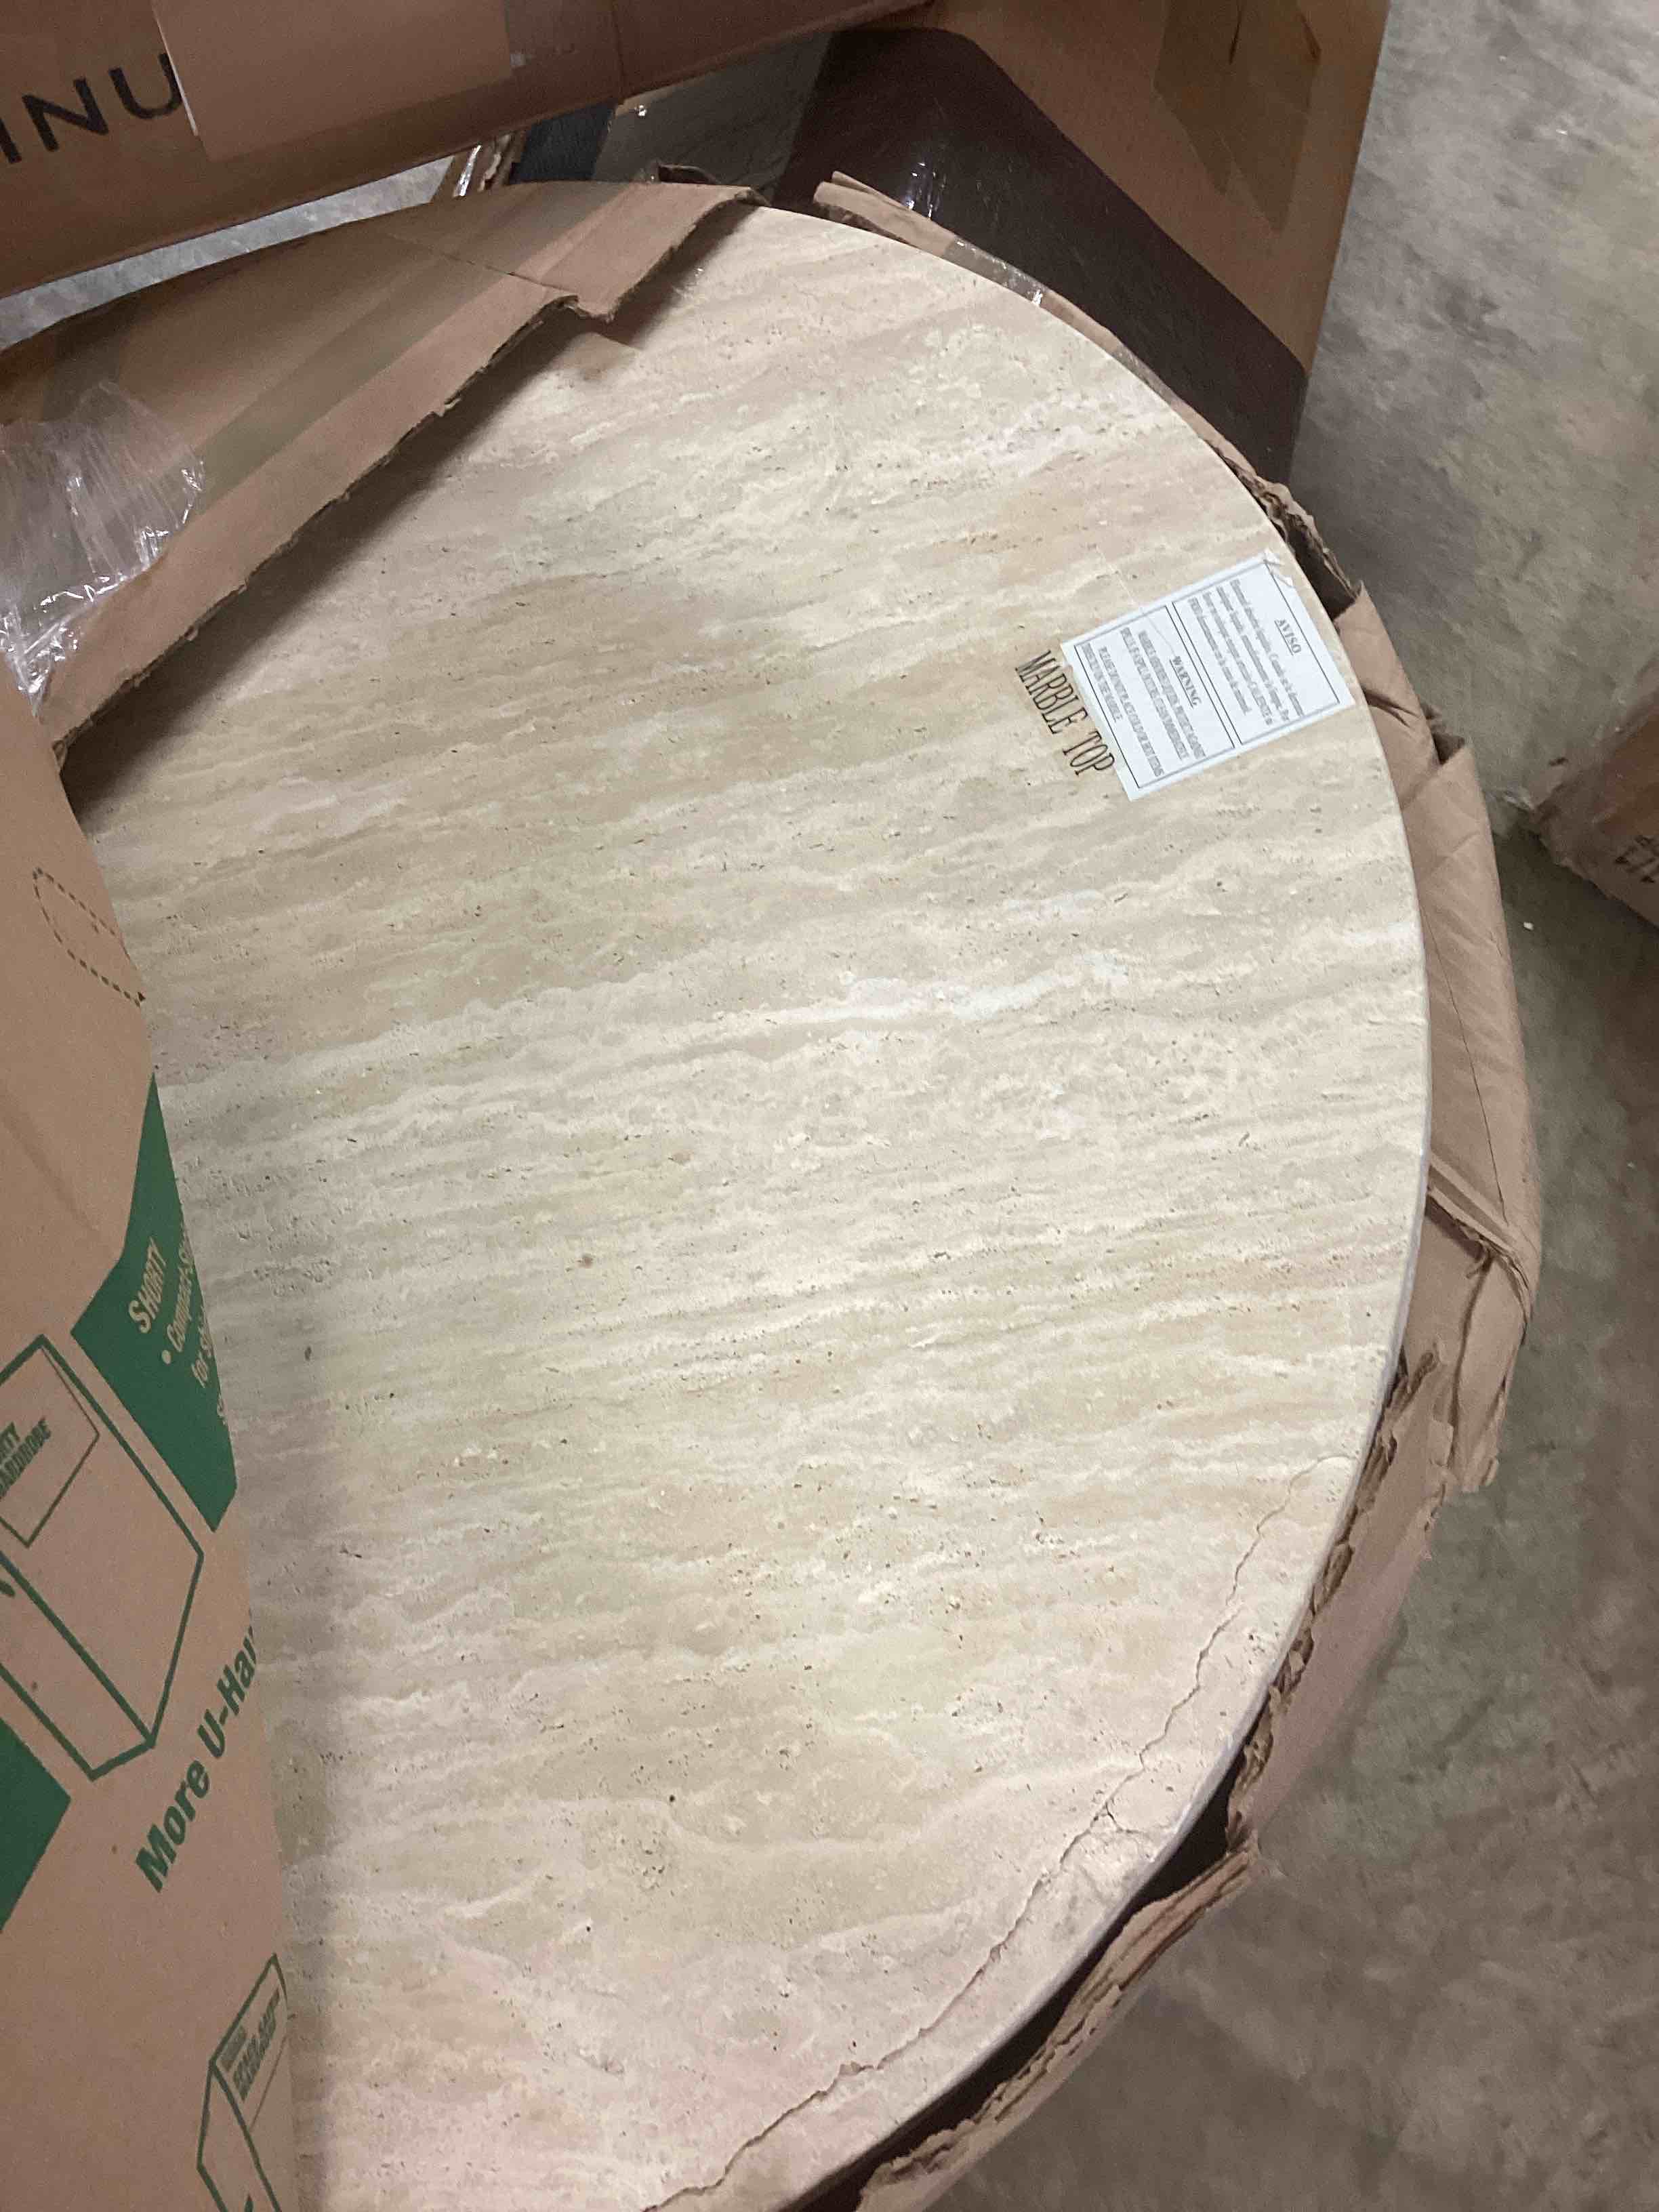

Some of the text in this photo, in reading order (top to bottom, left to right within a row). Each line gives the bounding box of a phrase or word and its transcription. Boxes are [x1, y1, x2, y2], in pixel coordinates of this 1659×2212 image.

[1276, 616, 1303, 654] AVISO
[1015, 649, 1088, 734] MARBLE
[1063, 730, 1115, 775] TOP
[1171, 655, 1202, 706] WARNING
[136, 1625, 256, 1893] More U-Ha
